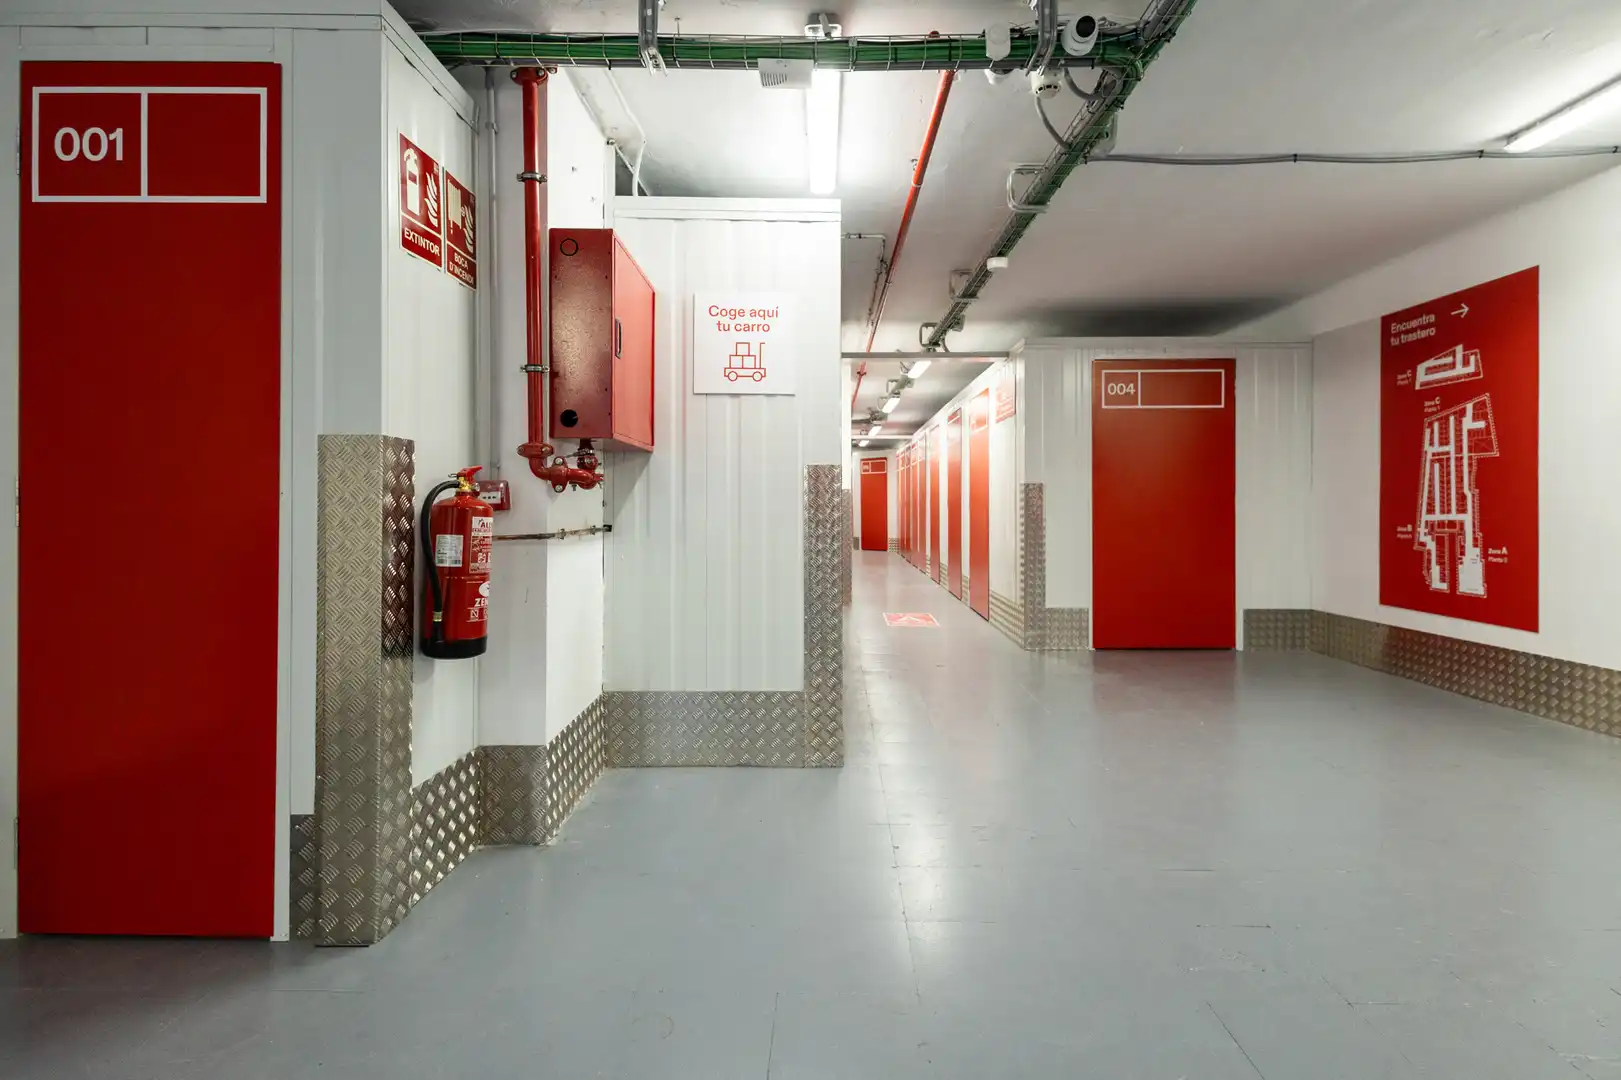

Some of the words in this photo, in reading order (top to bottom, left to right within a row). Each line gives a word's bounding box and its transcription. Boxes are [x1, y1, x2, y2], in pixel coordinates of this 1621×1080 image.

[53, 126, 124, 162] 001
[404, 227, 440, 256] EXTINTOR
[454, 252, 468, 270] BOCA
[708, 305, 745, 320] Coge
[749, 306, 779, 320] aquí
[716, 320, 731, 332] tu
[734, 323, 771, 332] carro
[1390, 313, 1436, 334] Encuentra
[1390, 337, 1400, 346] tu
[1400, 327, 1437, 344] trastero
[1107, 383, 1136, 396] 004
